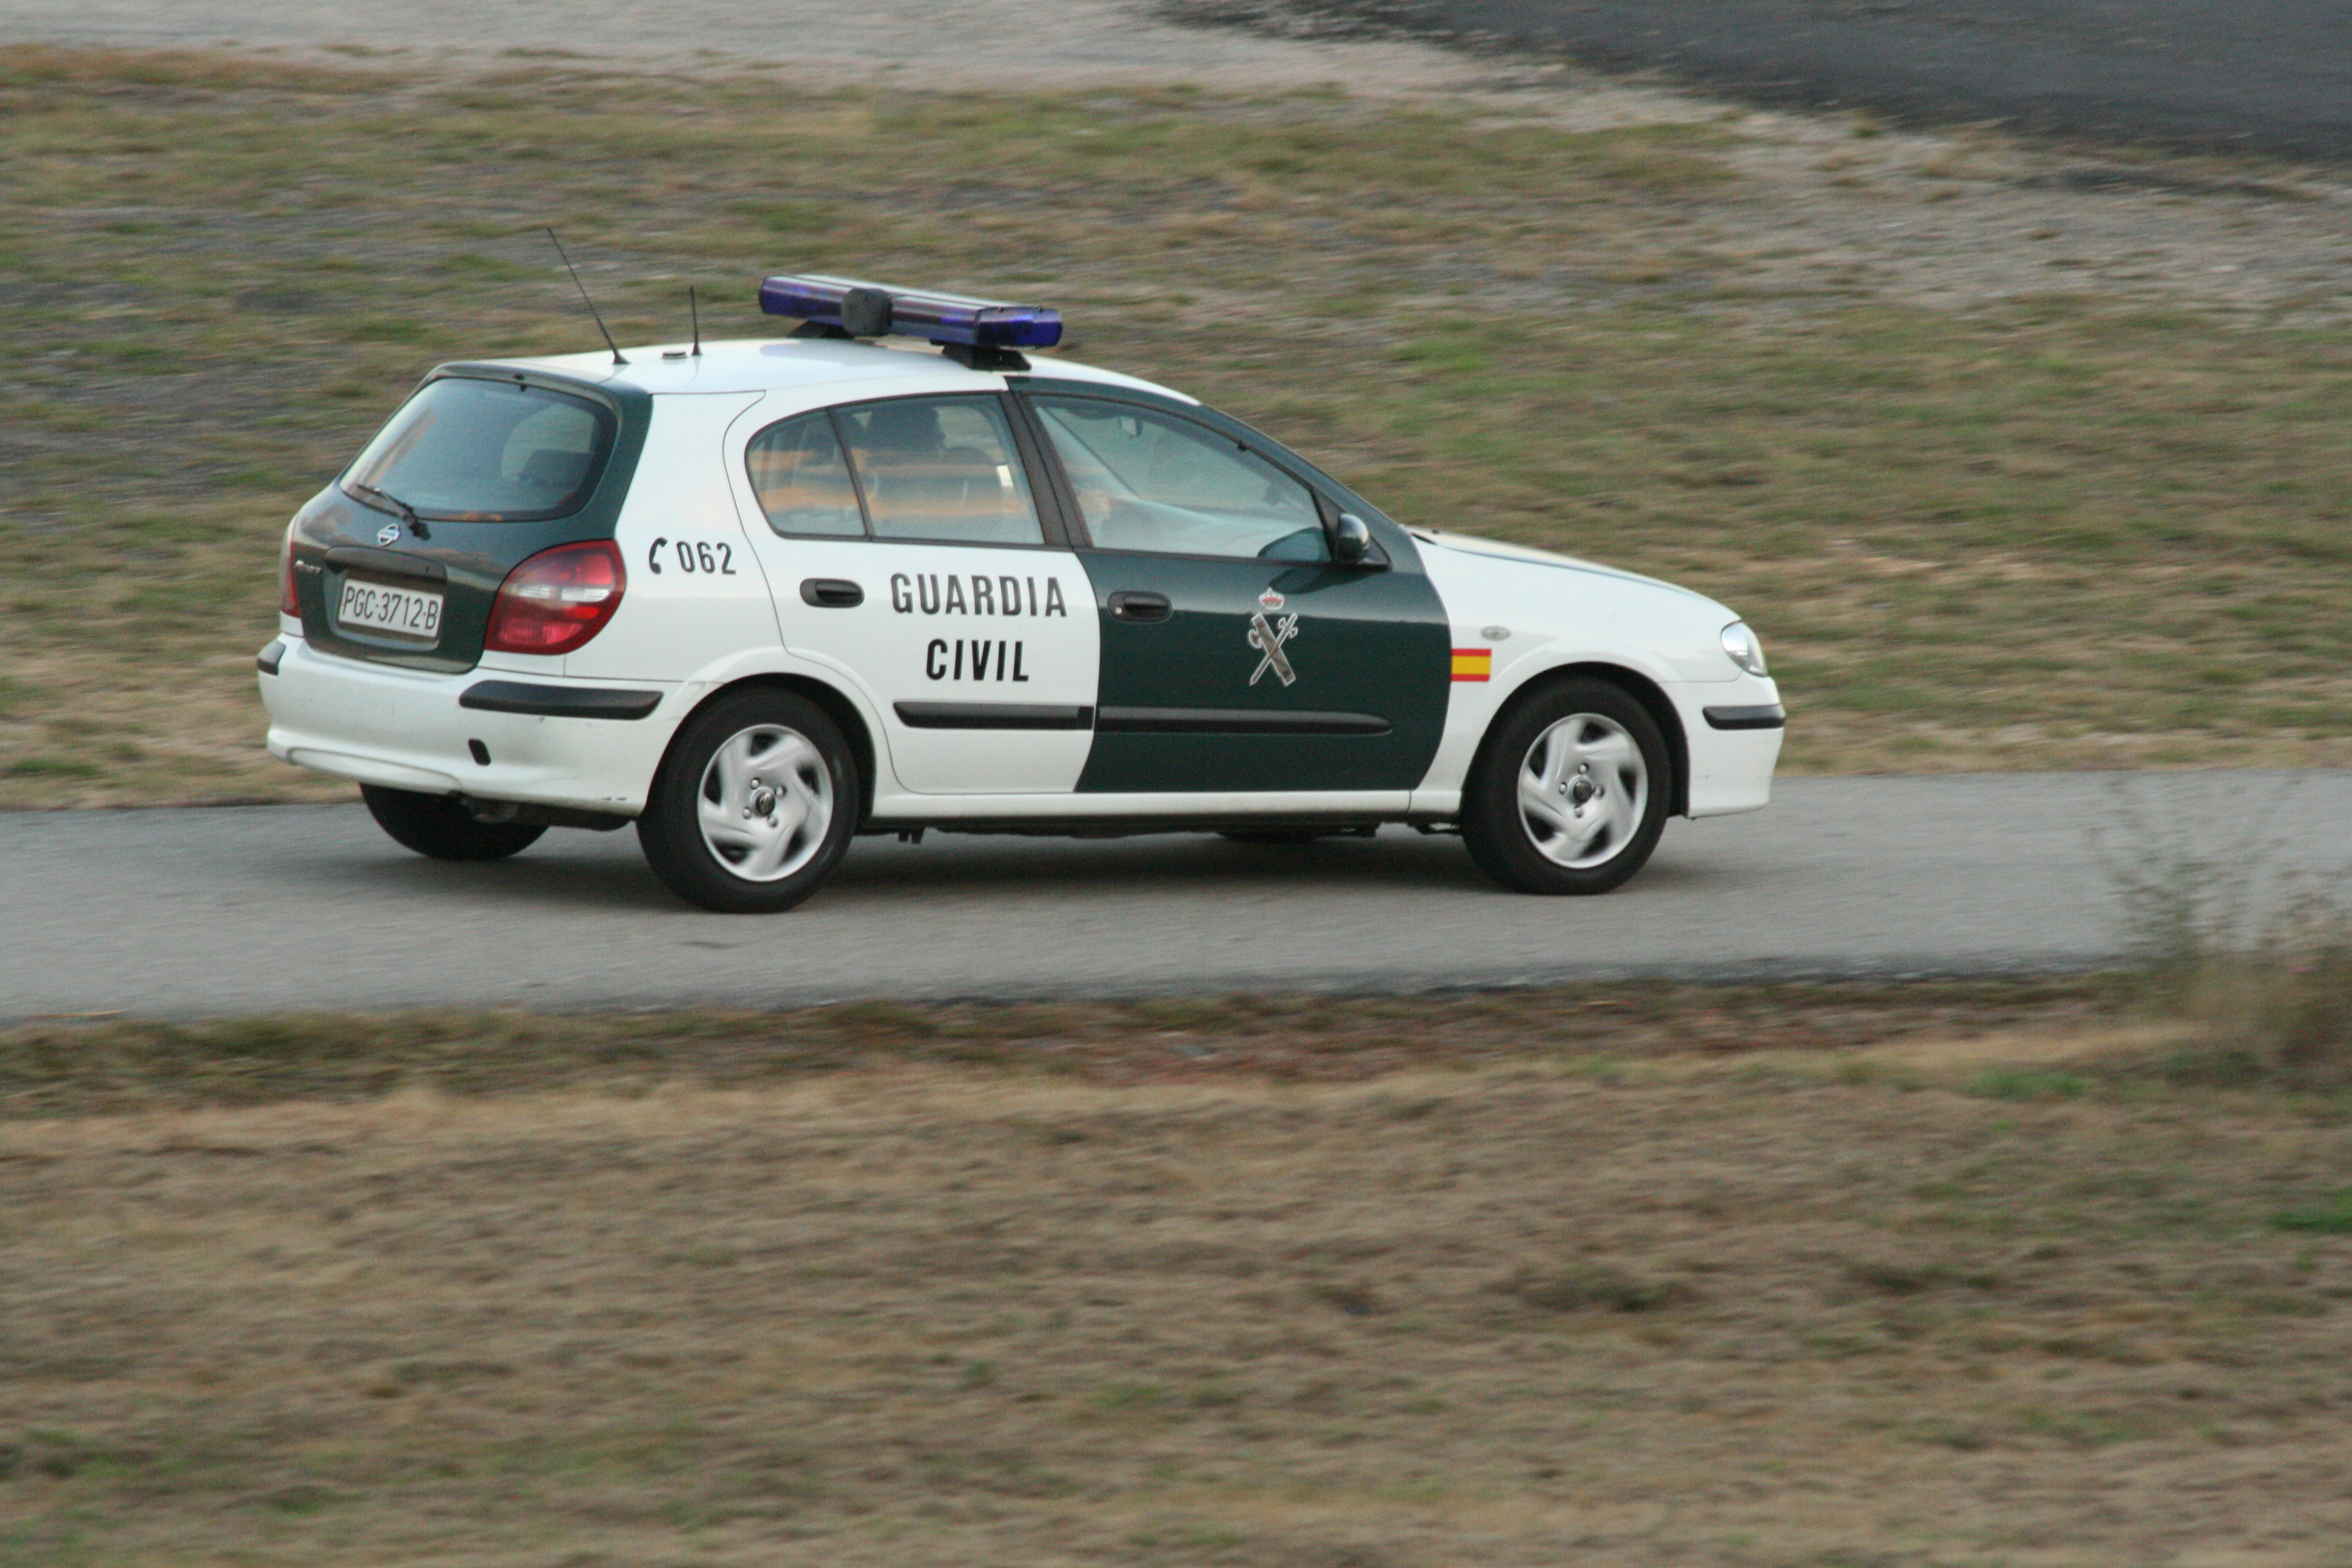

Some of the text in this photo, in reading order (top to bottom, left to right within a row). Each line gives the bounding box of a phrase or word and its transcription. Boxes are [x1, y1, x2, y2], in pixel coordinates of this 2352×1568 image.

[676, 541, 737, 575] 062
[890, 572, 1067, 617] GUARDIA
[926, 638, 1029, 682] CIVIL
